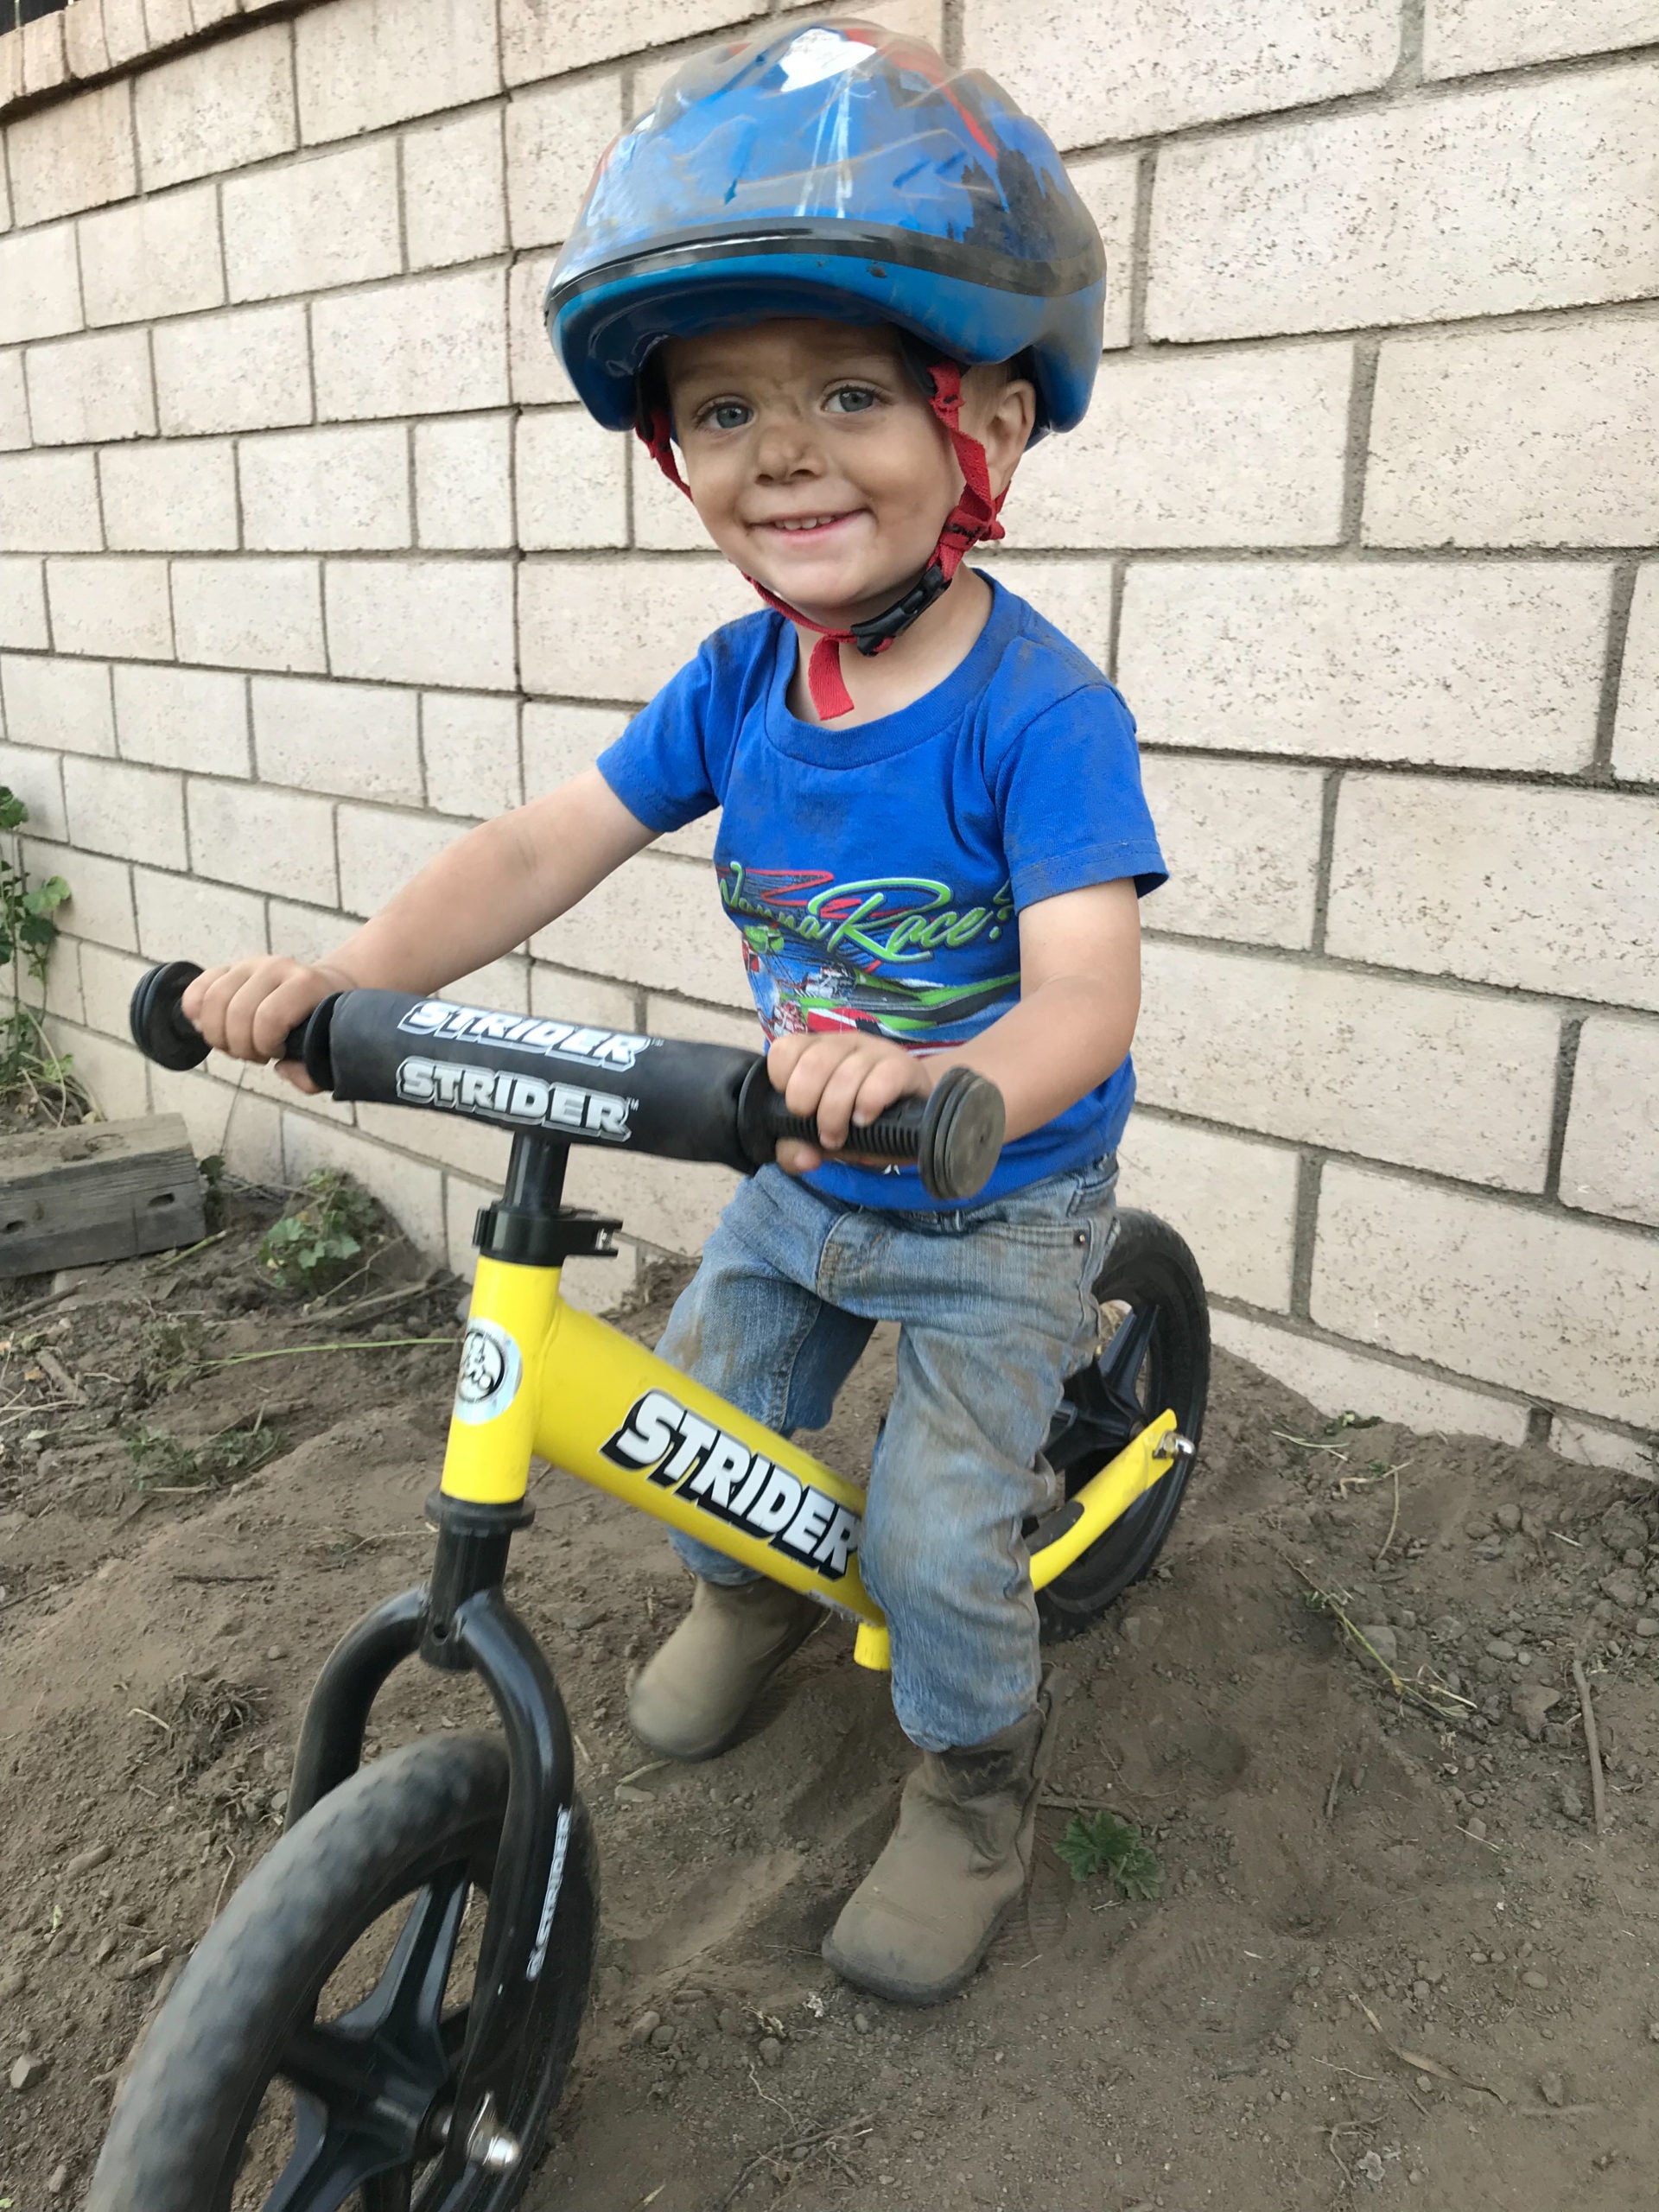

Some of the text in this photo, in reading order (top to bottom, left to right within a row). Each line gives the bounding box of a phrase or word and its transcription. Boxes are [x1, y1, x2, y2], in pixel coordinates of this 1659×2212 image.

[397, 999, 650, 1071] STRIDER
[397, 1055, 632, 1141] STRIDER
[600, 1389, 862, 1580] STRIDER
